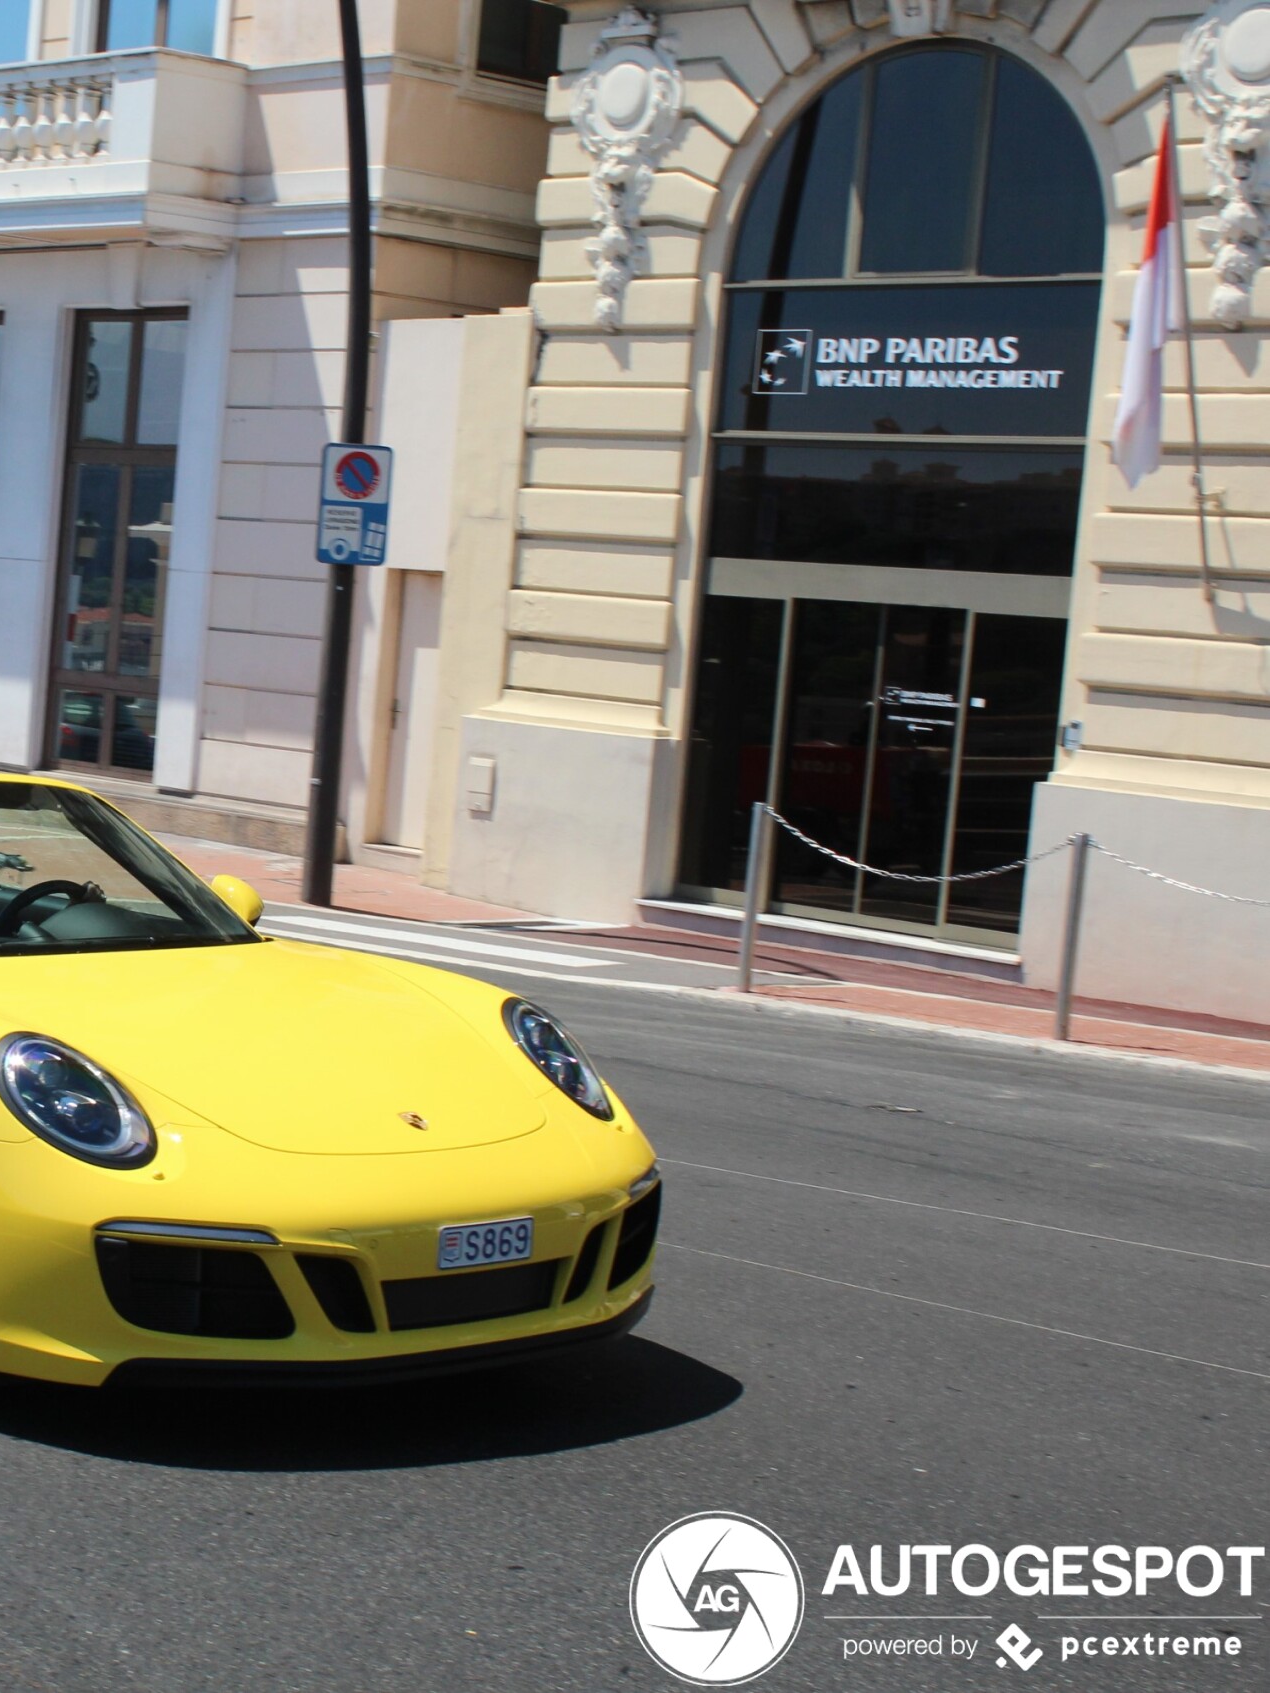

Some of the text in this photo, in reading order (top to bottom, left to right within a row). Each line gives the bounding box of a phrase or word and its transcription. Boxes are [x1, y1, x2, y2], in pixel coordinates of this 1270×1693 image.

[816, 337, 1020, 364] BNP PARIBAS
[815, 369, 1065, 388] WEALTH MANAGEMENT
[464, 1223, 529, 1261] S869
